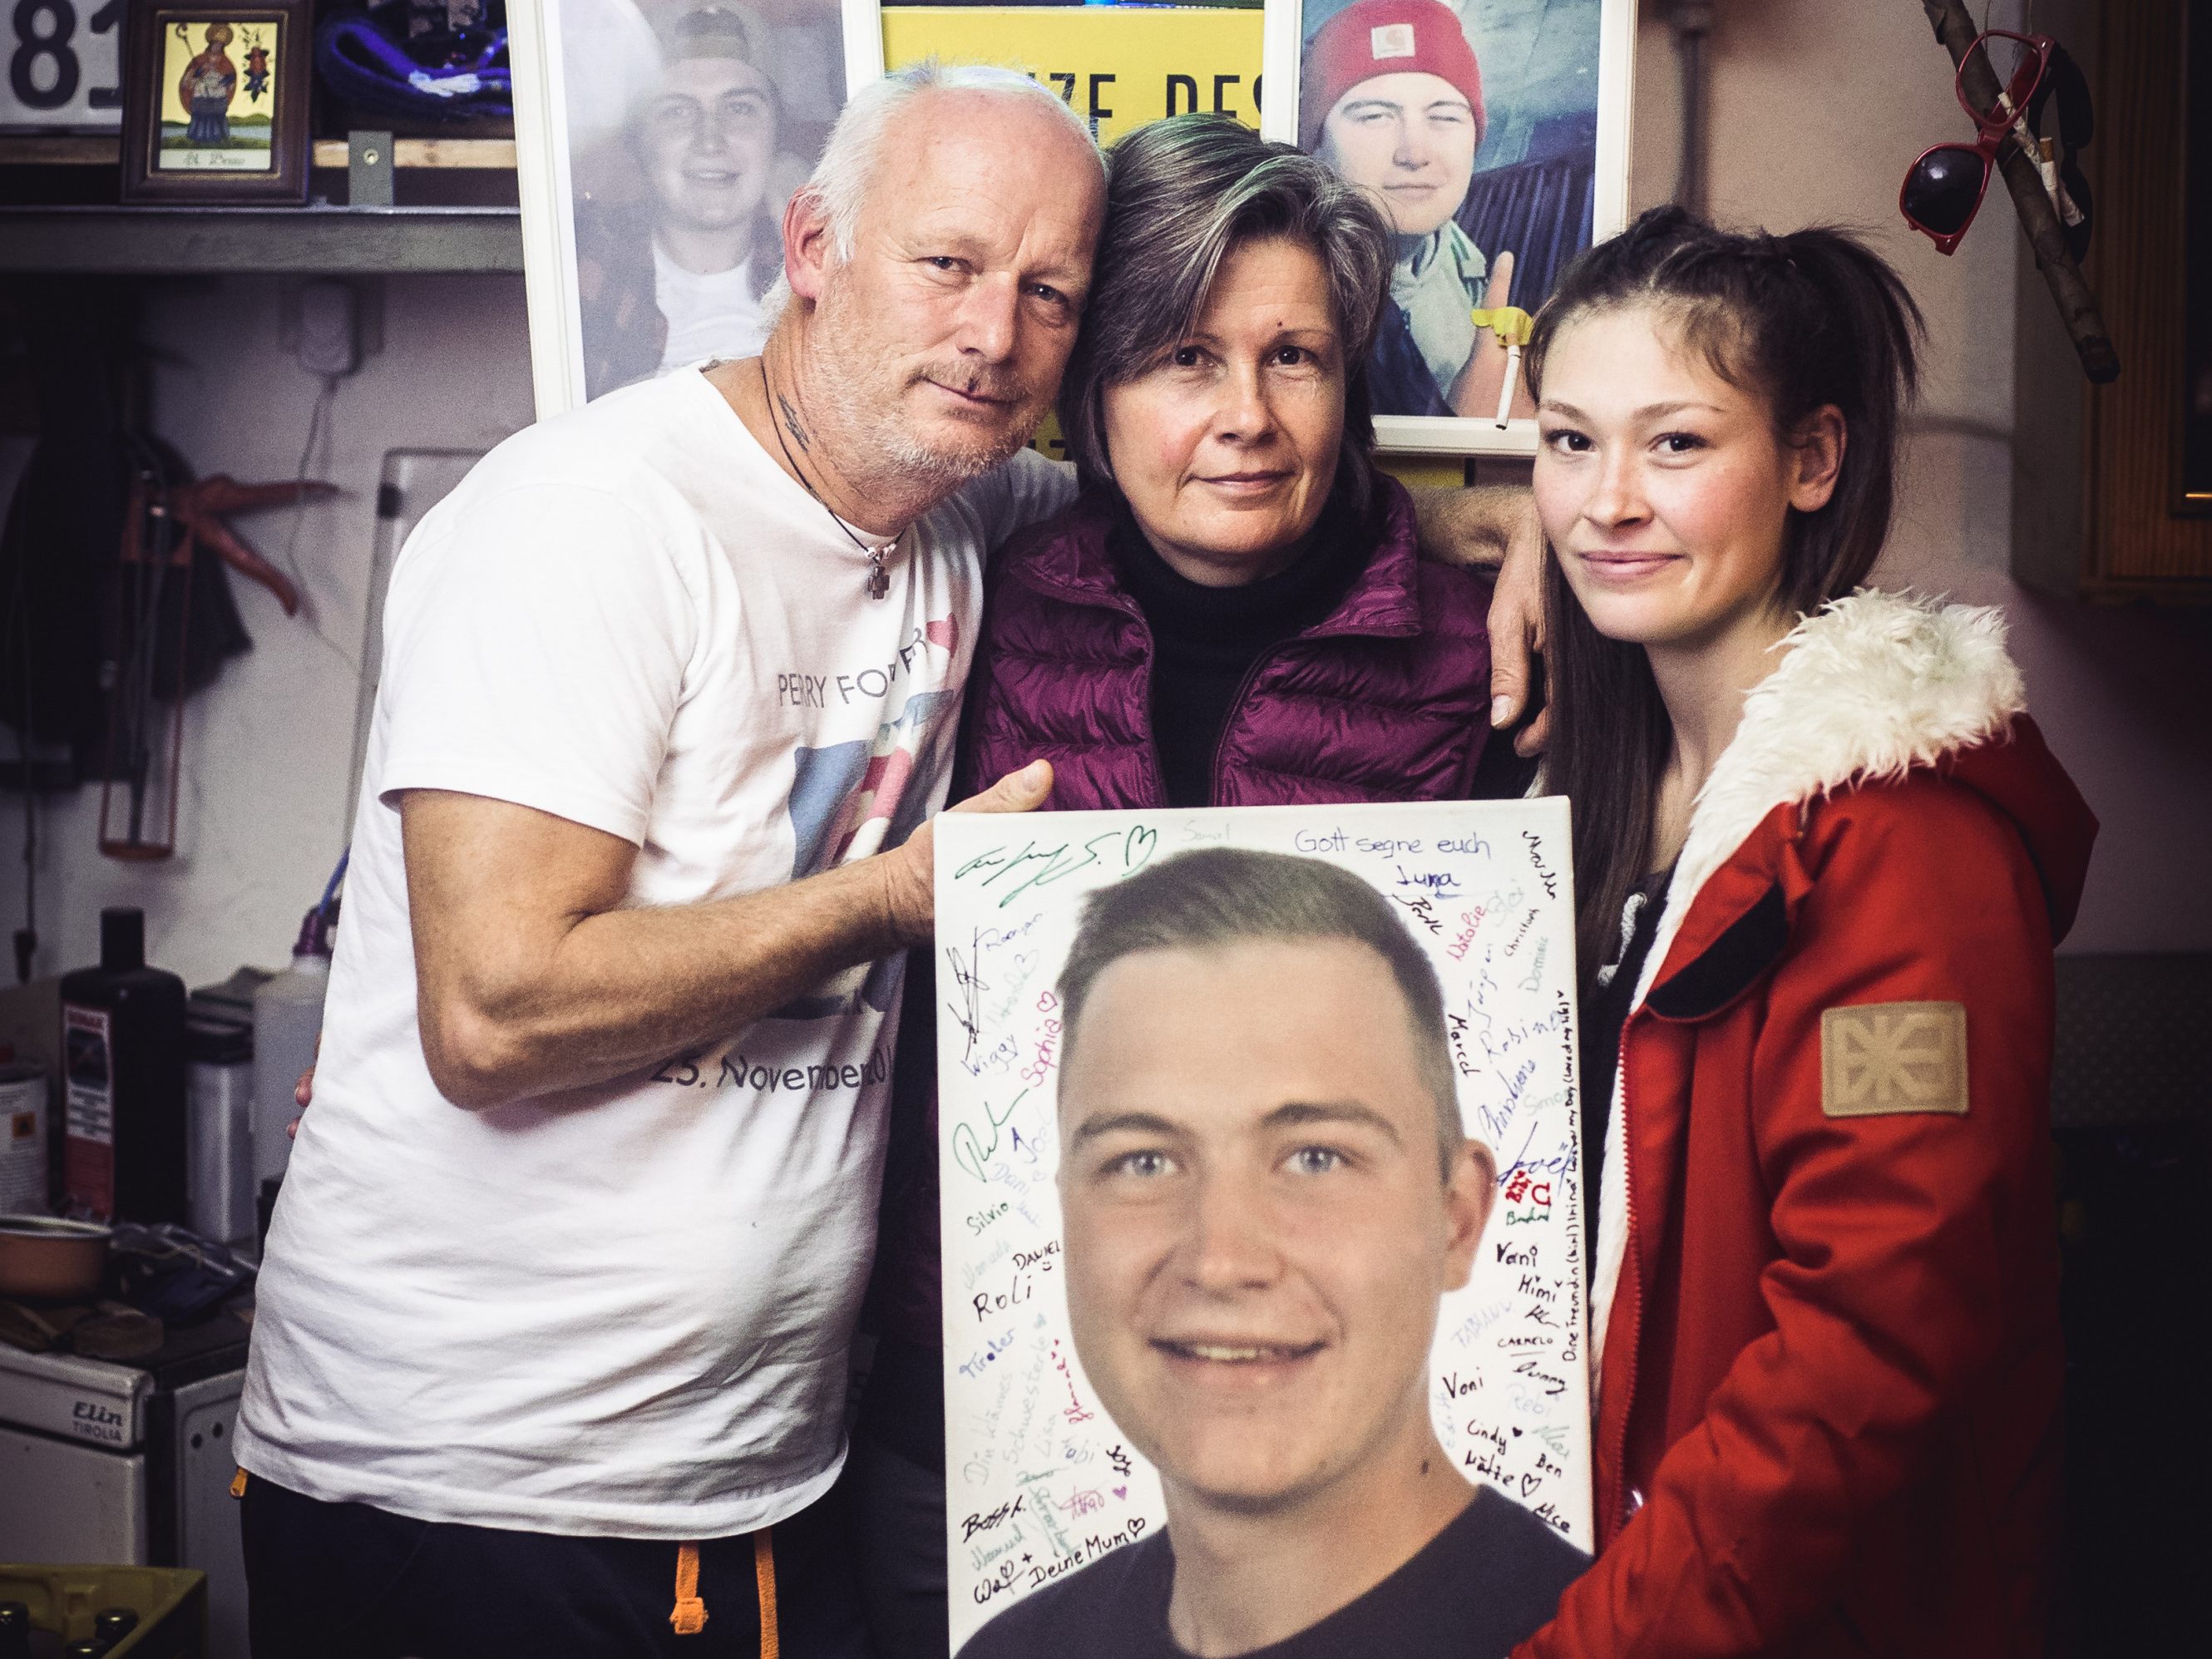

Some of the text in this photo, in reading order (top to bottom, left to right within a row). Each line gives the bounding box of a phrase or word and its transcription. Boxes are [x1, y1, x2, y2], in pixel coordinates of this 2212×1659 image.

[1025, 72, 1263, 143] ZE DE
[1295, 827, 1490, 860] Gott segne euch
[717, 1054, 871, 1094] November
[966, 1202, 1009, 1236] Silvio
[73, 1400, 122, 1427] Elin
[1085, 1532, 1131, 1559] Mum
